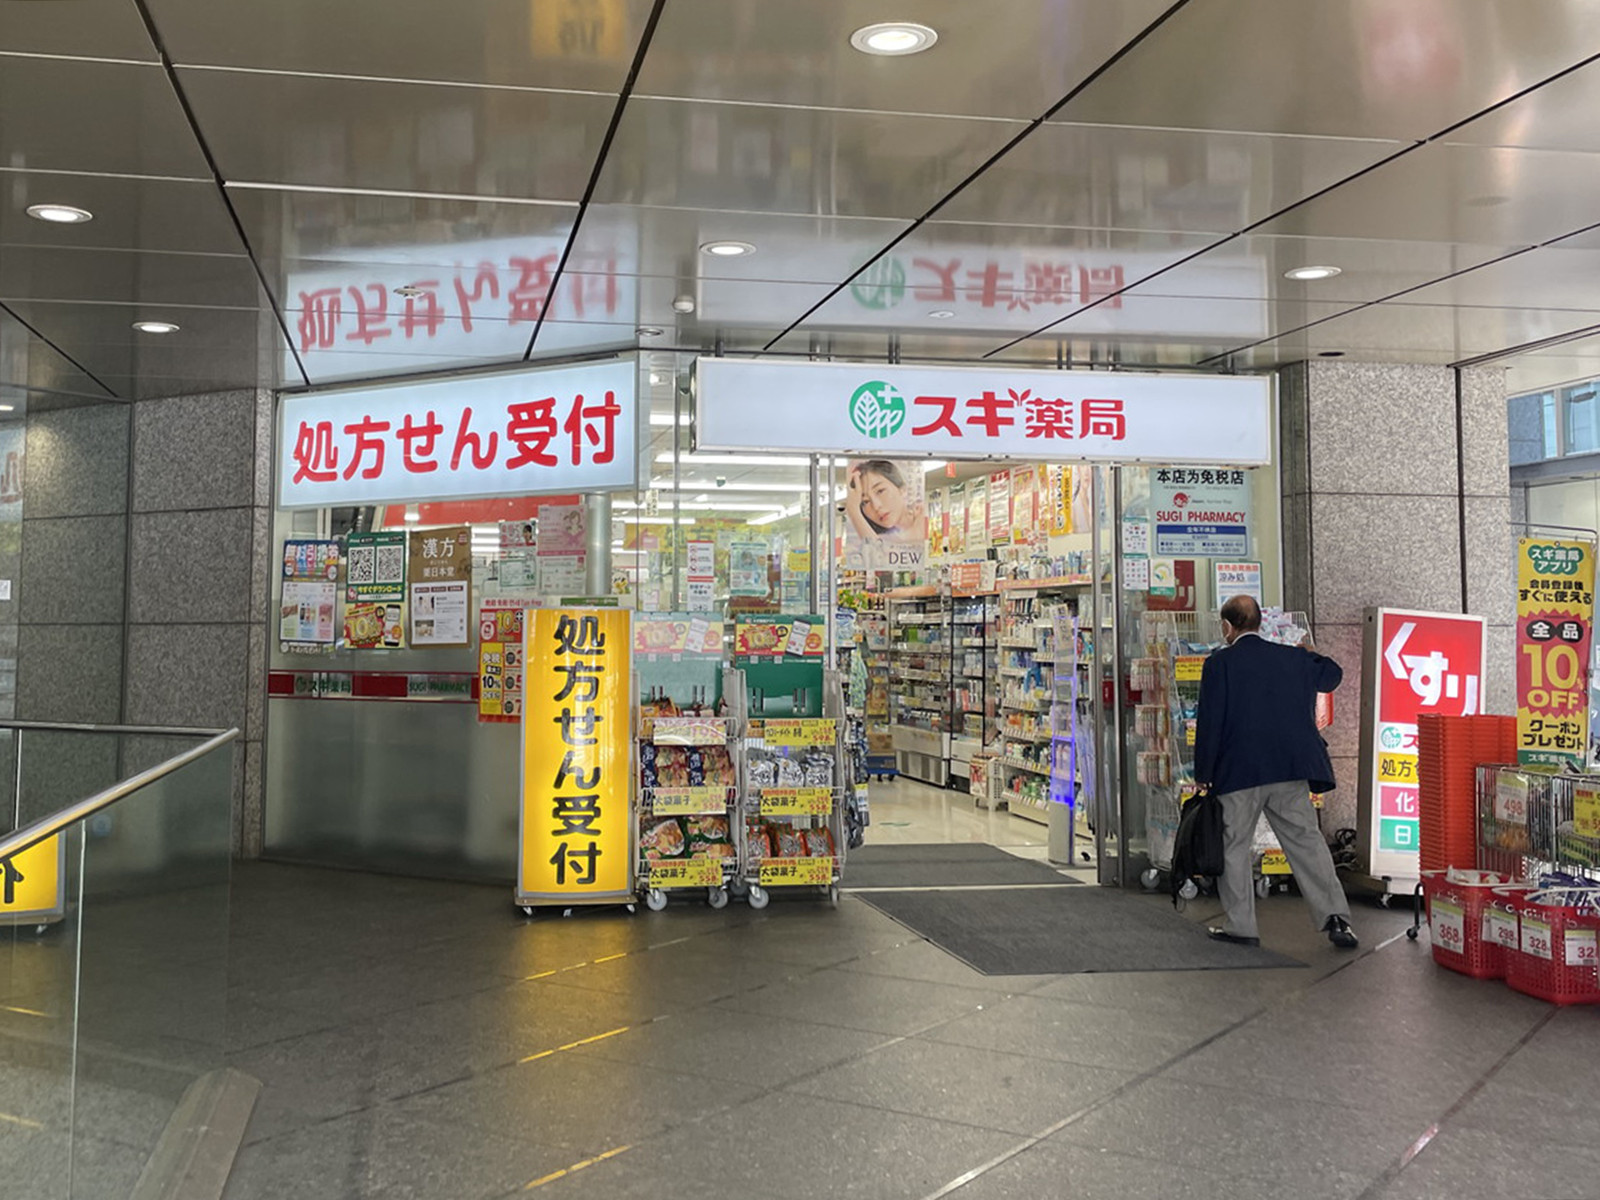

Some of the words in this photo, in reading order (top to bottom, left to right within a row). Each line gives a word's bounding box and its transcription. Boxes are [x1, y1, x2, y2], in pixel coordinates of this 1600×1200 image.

[912, 388, 1126, 440] スギ薬局
[293, 391, 621, 484] 処方せん受付
[1158, 469, 1244, 485] 本店为免税店
[1156, 511, 1182, 522] SUGI
[1188, 511, 1246, 523] PHARMACY
[423, 537, 455, 559] 漢方
[1531, 548, 1580, 562] スギ薬局
[888, 551, 921, 564] DEW
[1538, 560, 1574, 573] アプリ
[1519, 589, 1592, 604] すぐに使える
[1532, 621, 1579, 640] 全品
[1384, 622, 1478, 716] くすり
[1527, 690, 1579, 709] OFF
[1529, 719, 1581, 735] クーポン
[550, 614, 605, 884] 処方せん受付
[1523, 734, 1584, 750] プレゼント
[762, 795, 798, 807] 大袋菓子
[1504, 799, 1523, 816] 498
[650, 869, 687, 879] 大袋菓子
[761, 868, 797, 879] 大袋菓子
[1439, 924, 1459, 943] 368
[1498, 927, 1514, 941] 298
[1529, 936, 1547, 951] 328
